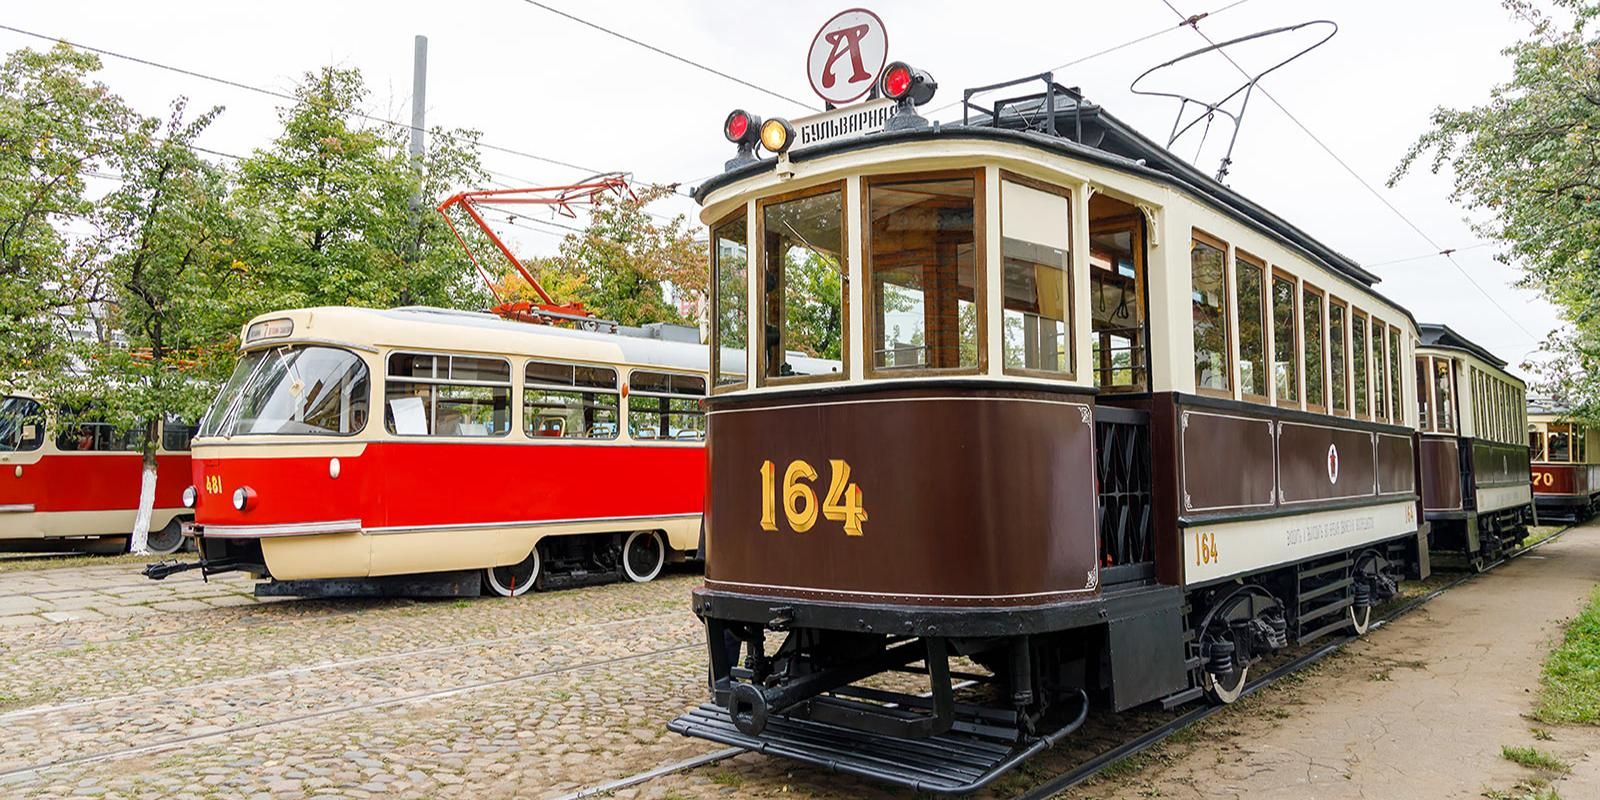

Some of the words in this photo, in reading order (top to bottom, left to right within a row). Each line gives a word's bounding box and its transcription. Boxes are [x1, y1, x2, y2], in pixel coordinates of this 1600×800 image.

[206, 475, 223, 495] 481
[760, 459, 868, 536] 164
[1195, 531, 1218, 567] 164
